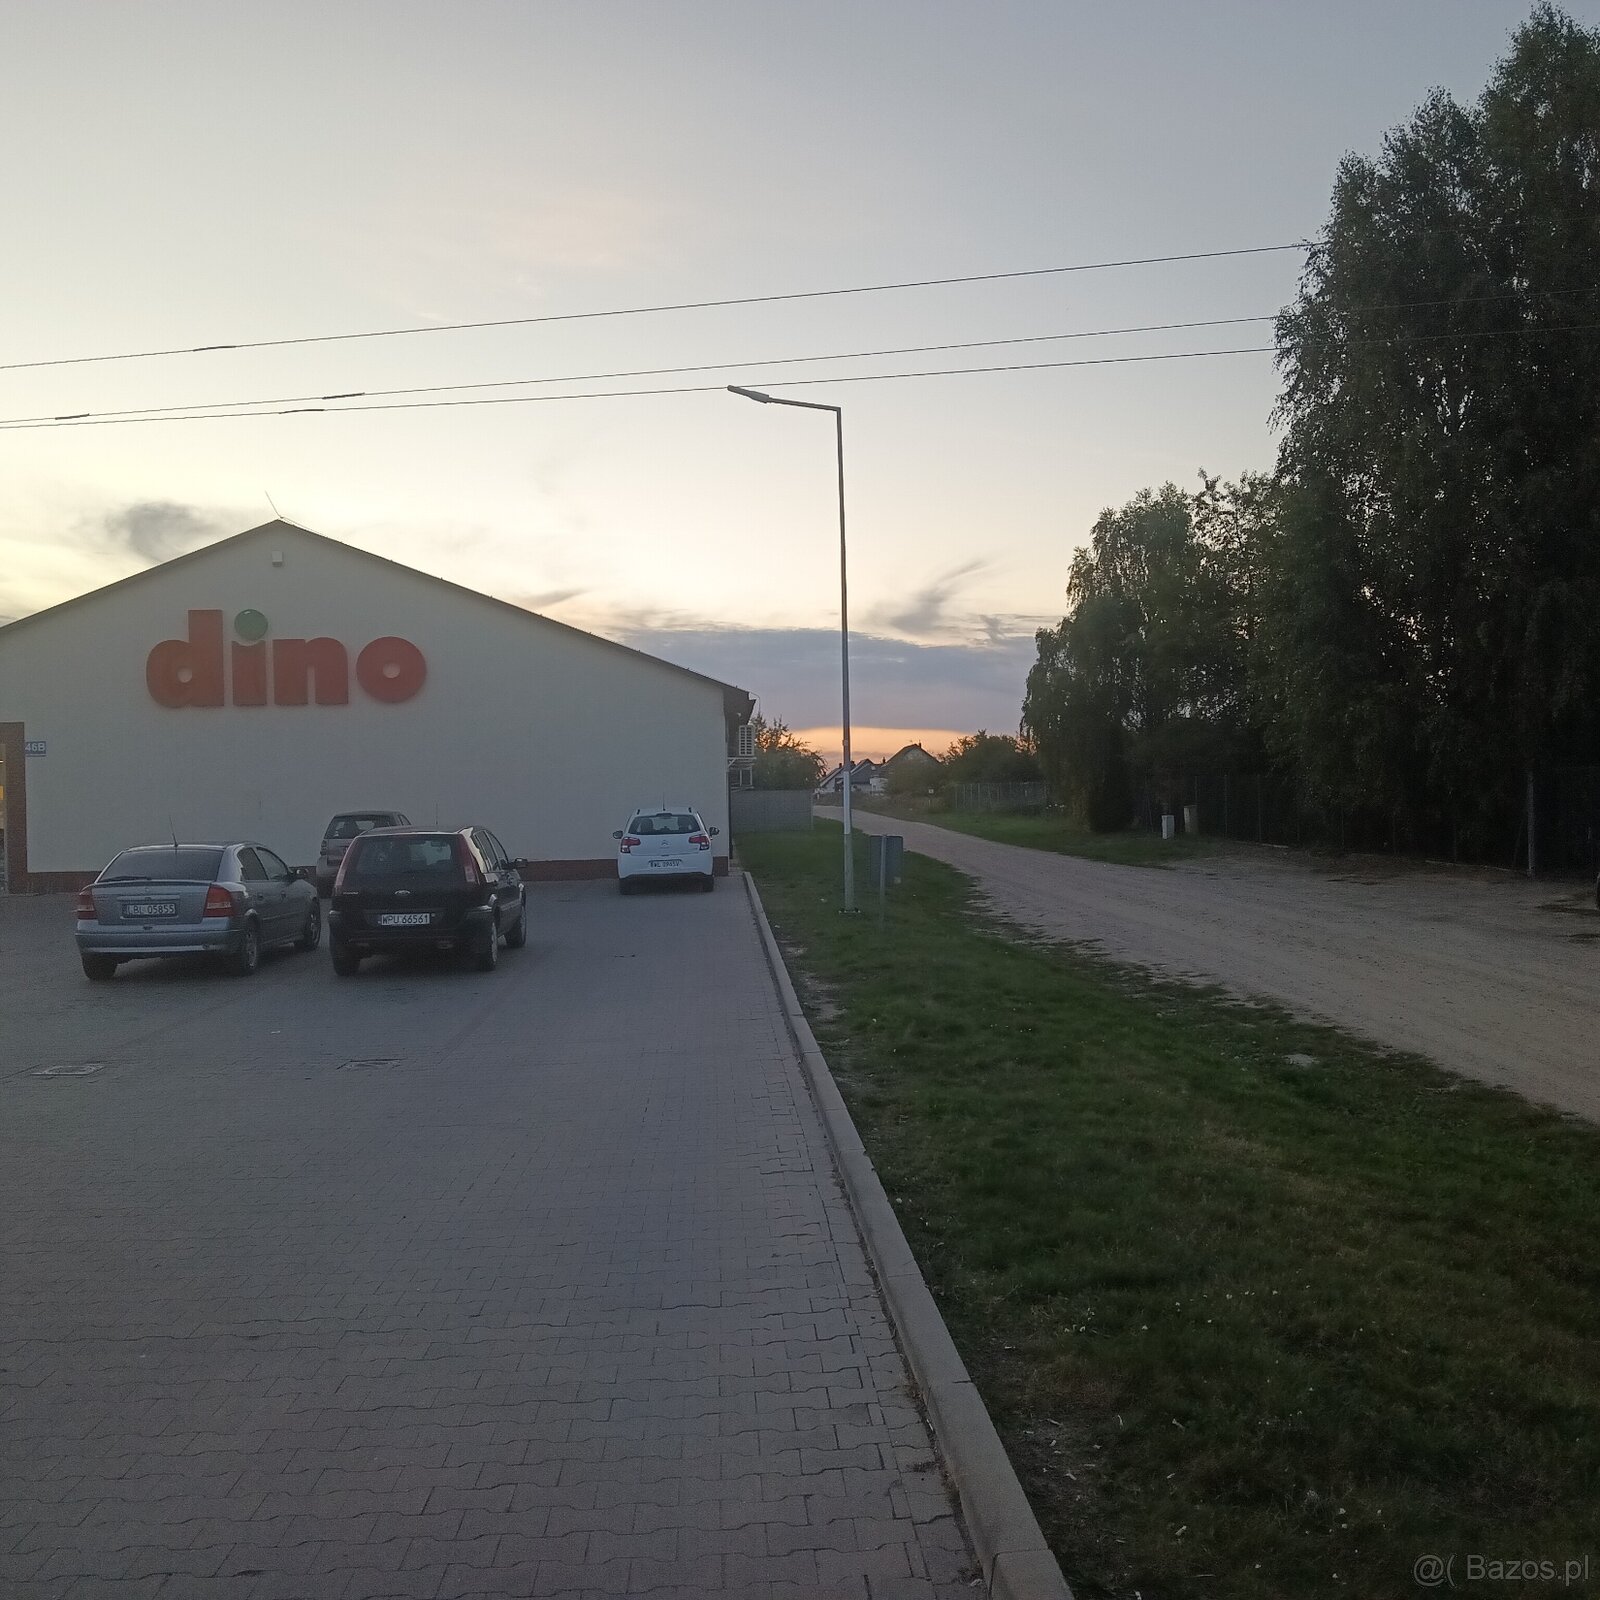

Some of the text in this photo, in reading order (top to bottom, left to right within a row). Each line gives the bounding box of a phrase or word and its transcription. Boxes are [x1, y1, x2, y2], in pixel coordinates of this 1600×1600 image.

[146, 609, 427, 707] dino
[25, 742, 46, 752] 46B
[382, 914, 428, 924] WPU 66561
